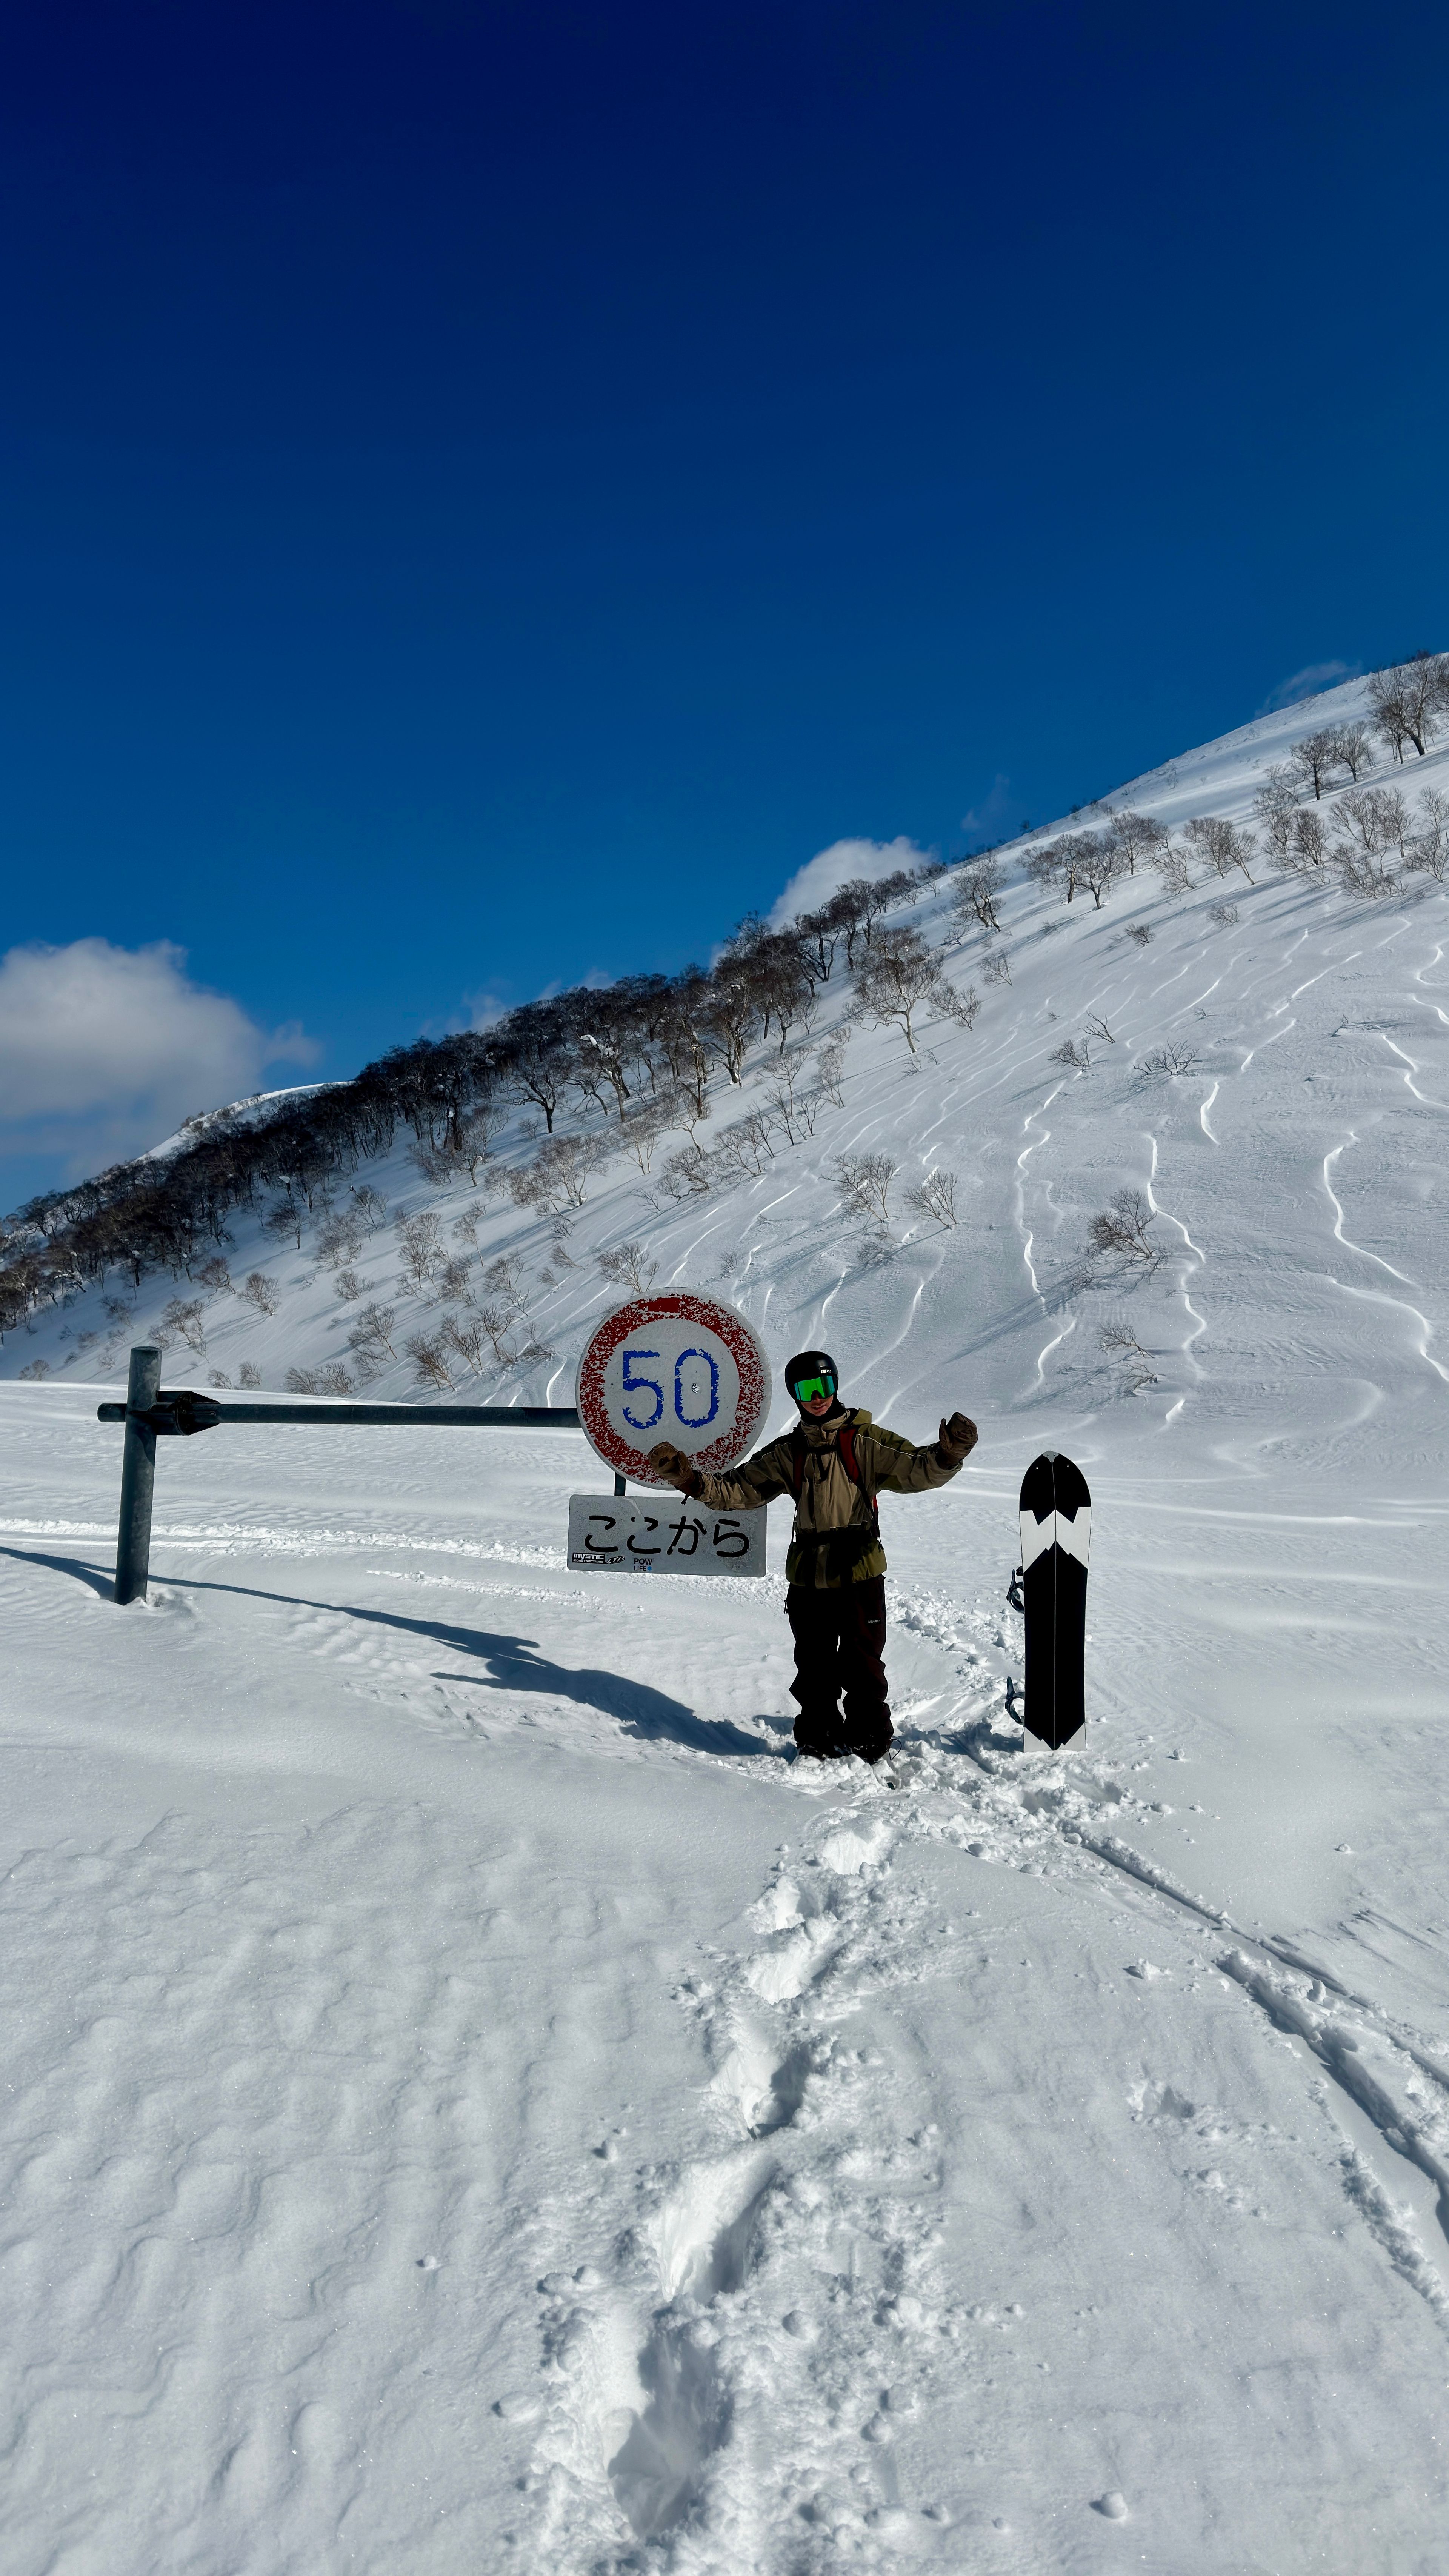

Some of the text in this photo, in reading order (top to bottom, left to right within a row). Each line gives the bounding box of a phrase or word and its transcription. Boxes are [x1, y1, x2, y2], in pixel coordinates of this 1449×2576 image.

[623, 1348, 719, 1430] 50
[585, 1515, 750, 1558] ここから
